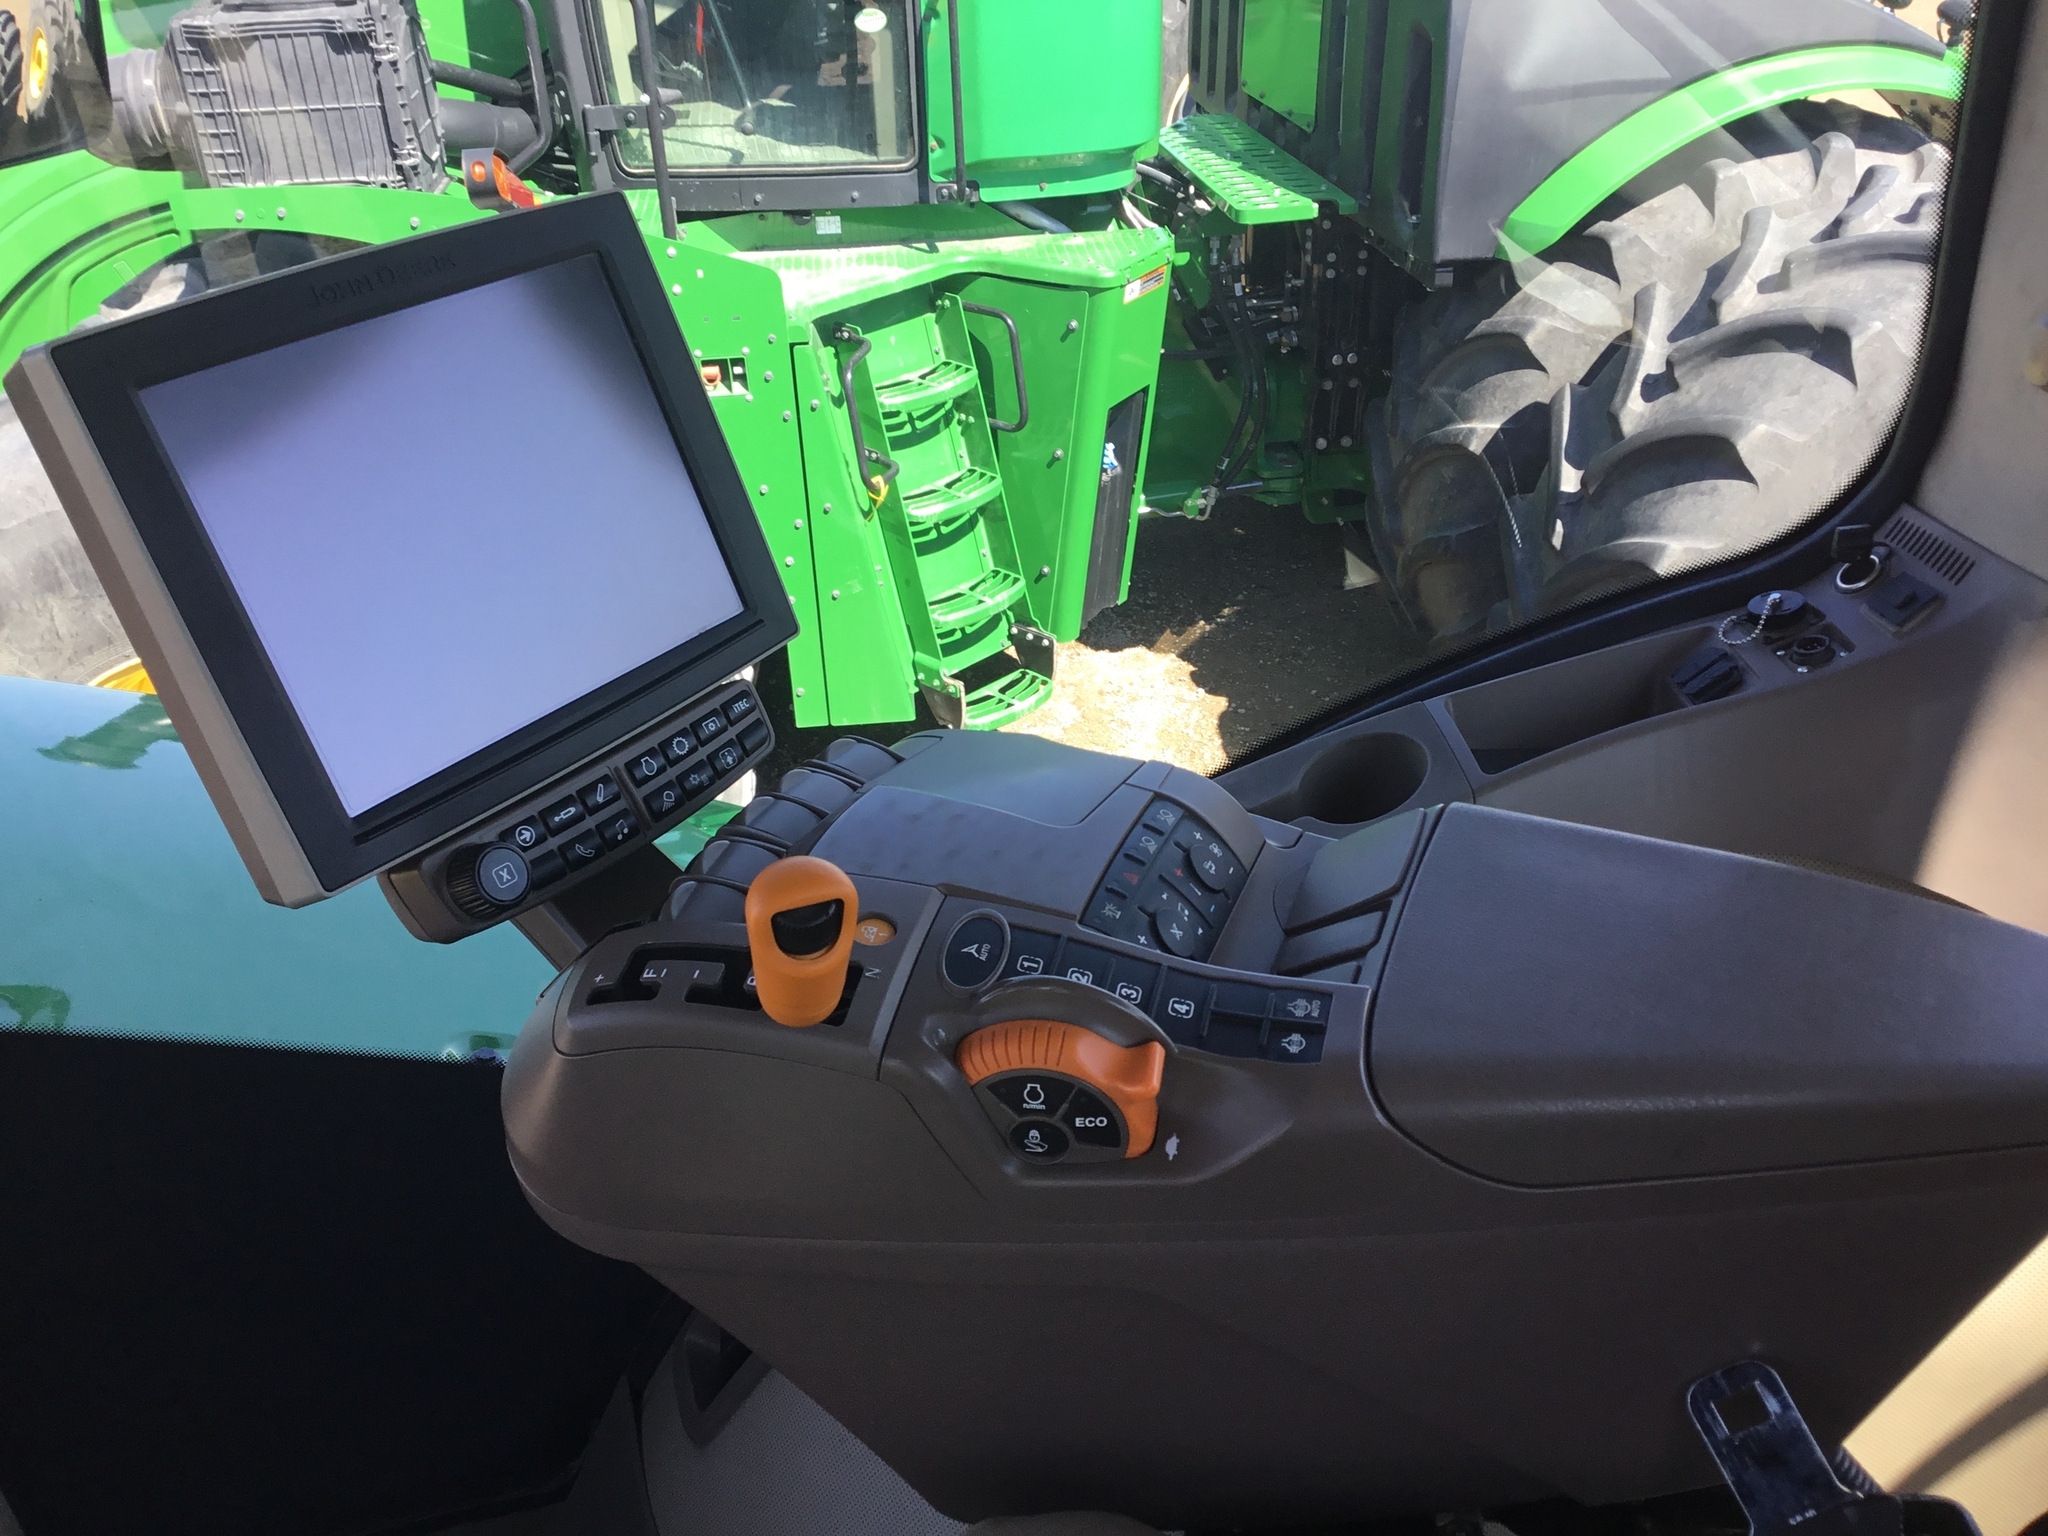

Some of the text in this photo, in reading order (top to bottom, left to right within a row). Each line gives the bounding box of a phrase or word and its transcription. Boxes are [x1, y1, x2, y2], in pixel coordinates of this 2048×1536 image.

[979, 943, 991, 961] AUTO
[864, 967, 882, 979] N
[1071, 972, 1088, 984] 2
[1121, 988, 1137, 998] 3
[1173, 1003, 1190, 1014] 4
[1075, 1116, 1108, 1127] ECO
